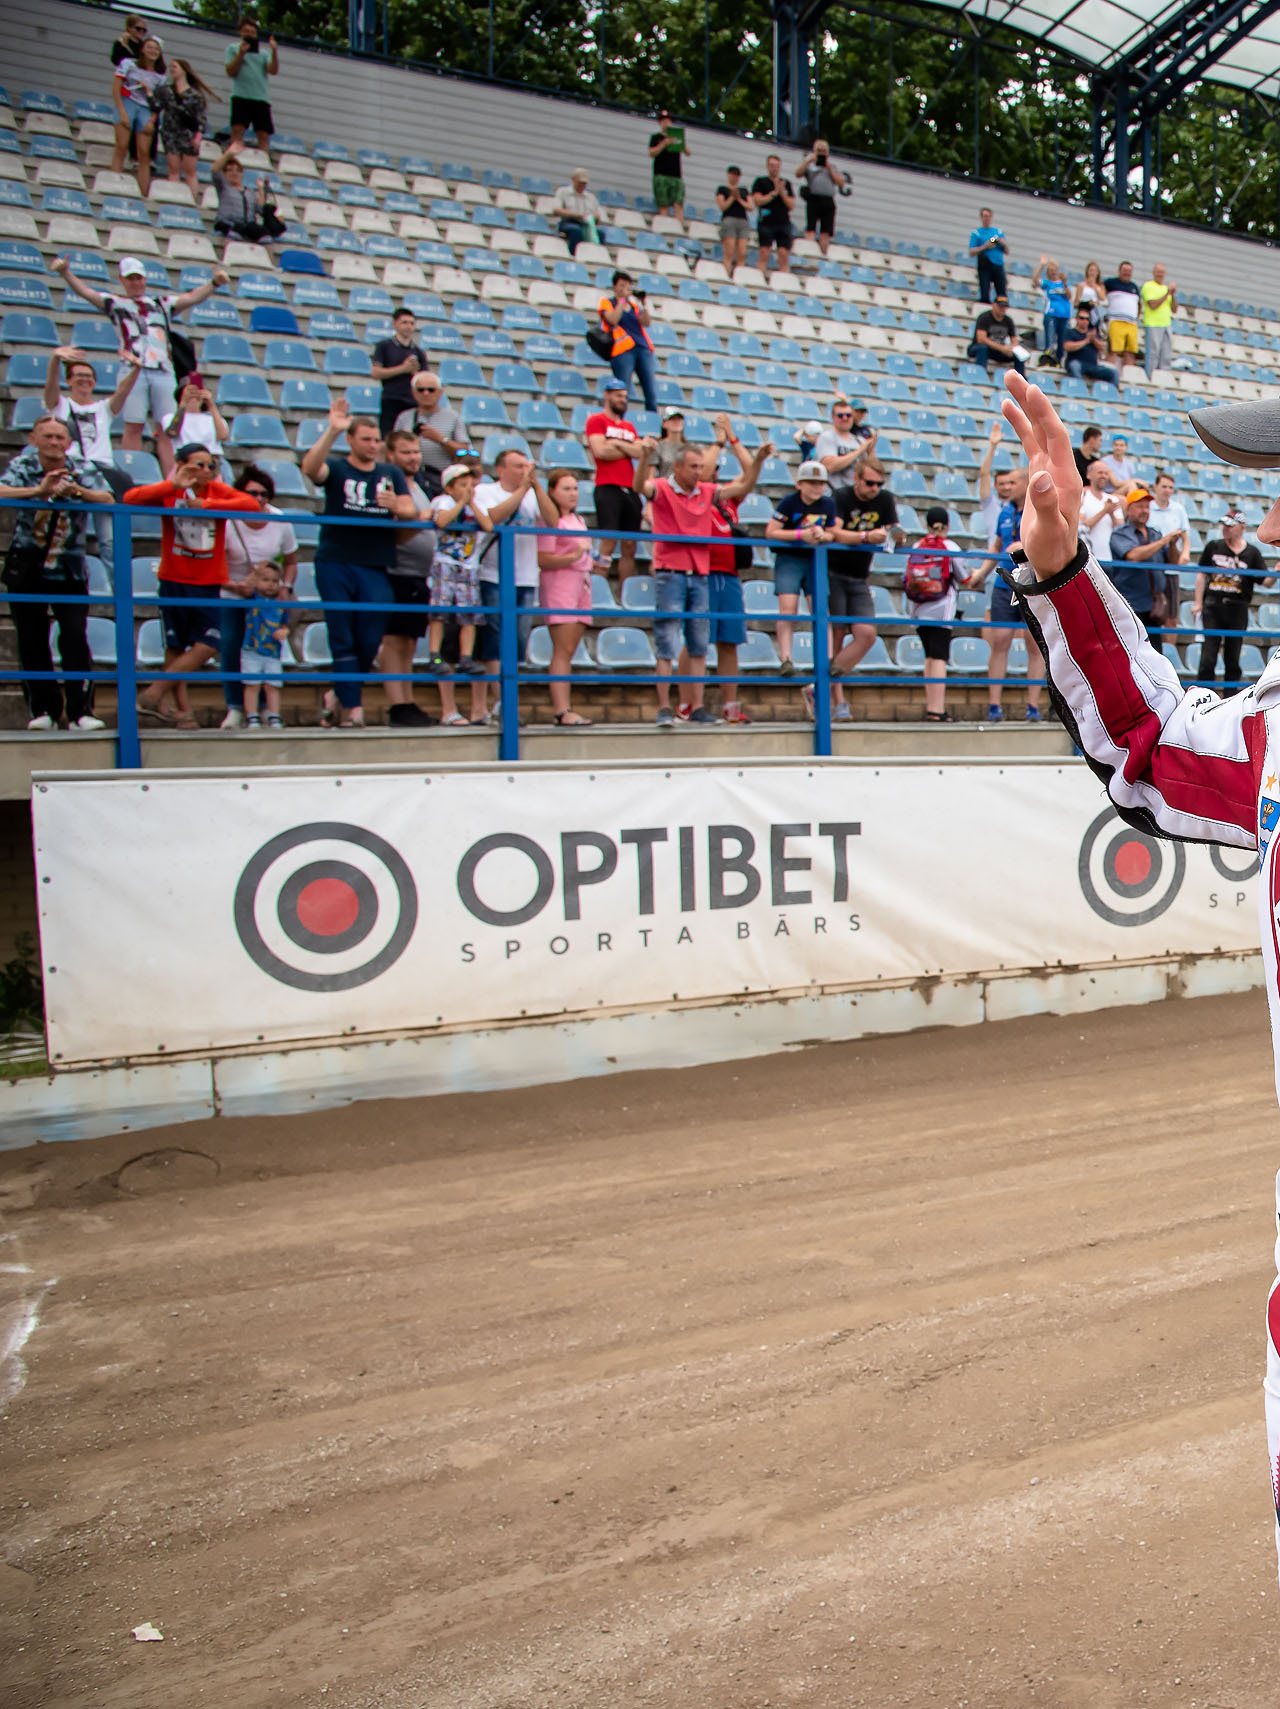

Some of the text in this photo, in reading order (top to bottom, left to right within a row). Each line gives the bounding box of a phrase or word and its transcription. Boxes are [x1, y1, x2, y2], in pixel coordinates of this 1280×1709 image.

[457, 821, 861, 926] OPTIBET
[460, 912, 862, 963] SPORTA BĀRS
